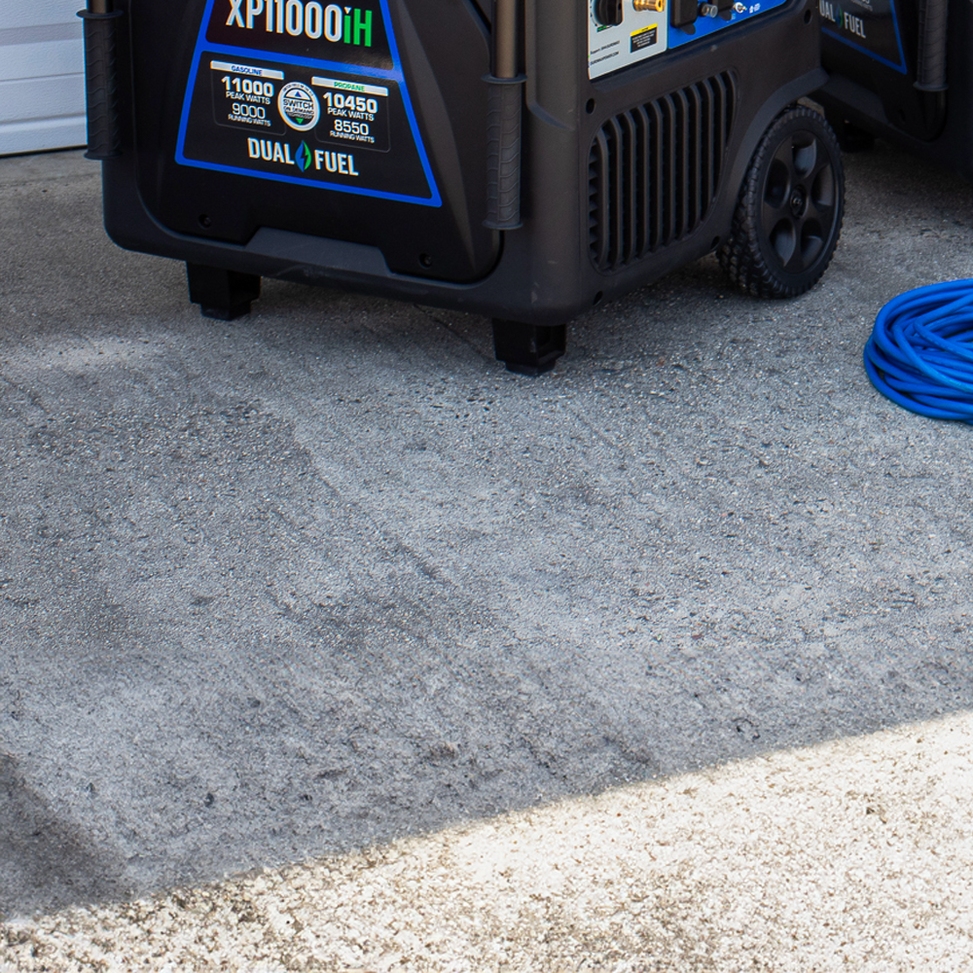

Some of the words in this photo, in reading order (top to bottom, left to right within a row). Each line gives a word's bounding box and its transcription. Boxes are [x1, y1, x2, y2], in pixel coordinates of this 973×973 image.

[843, 11, 867, 39] FUEL
[231, 65, 263, 77] GASOLINE
[221, 75, 275, 98] 11000
[333, 81, 365, 92] PROPANE
[225, 90, 245, 101] PEAK
[245, 94, 271, 105] WATTS
[283, 98, 315, 111] SWITCH
[323, 91, 378, 114] 10450
[231, 102, 266, 119] 9000
[327, 106, 347, 117] PEAK
[348, 110, 375, 122] WATTS
[334, 119, 369, 136] 8550
[329, 130, 355, 141] RUNNING
[355, 134, 375, 144] WATTS
[247, 137, 295, 165] DUAL
[314, 149, 359, 176] FUEL
